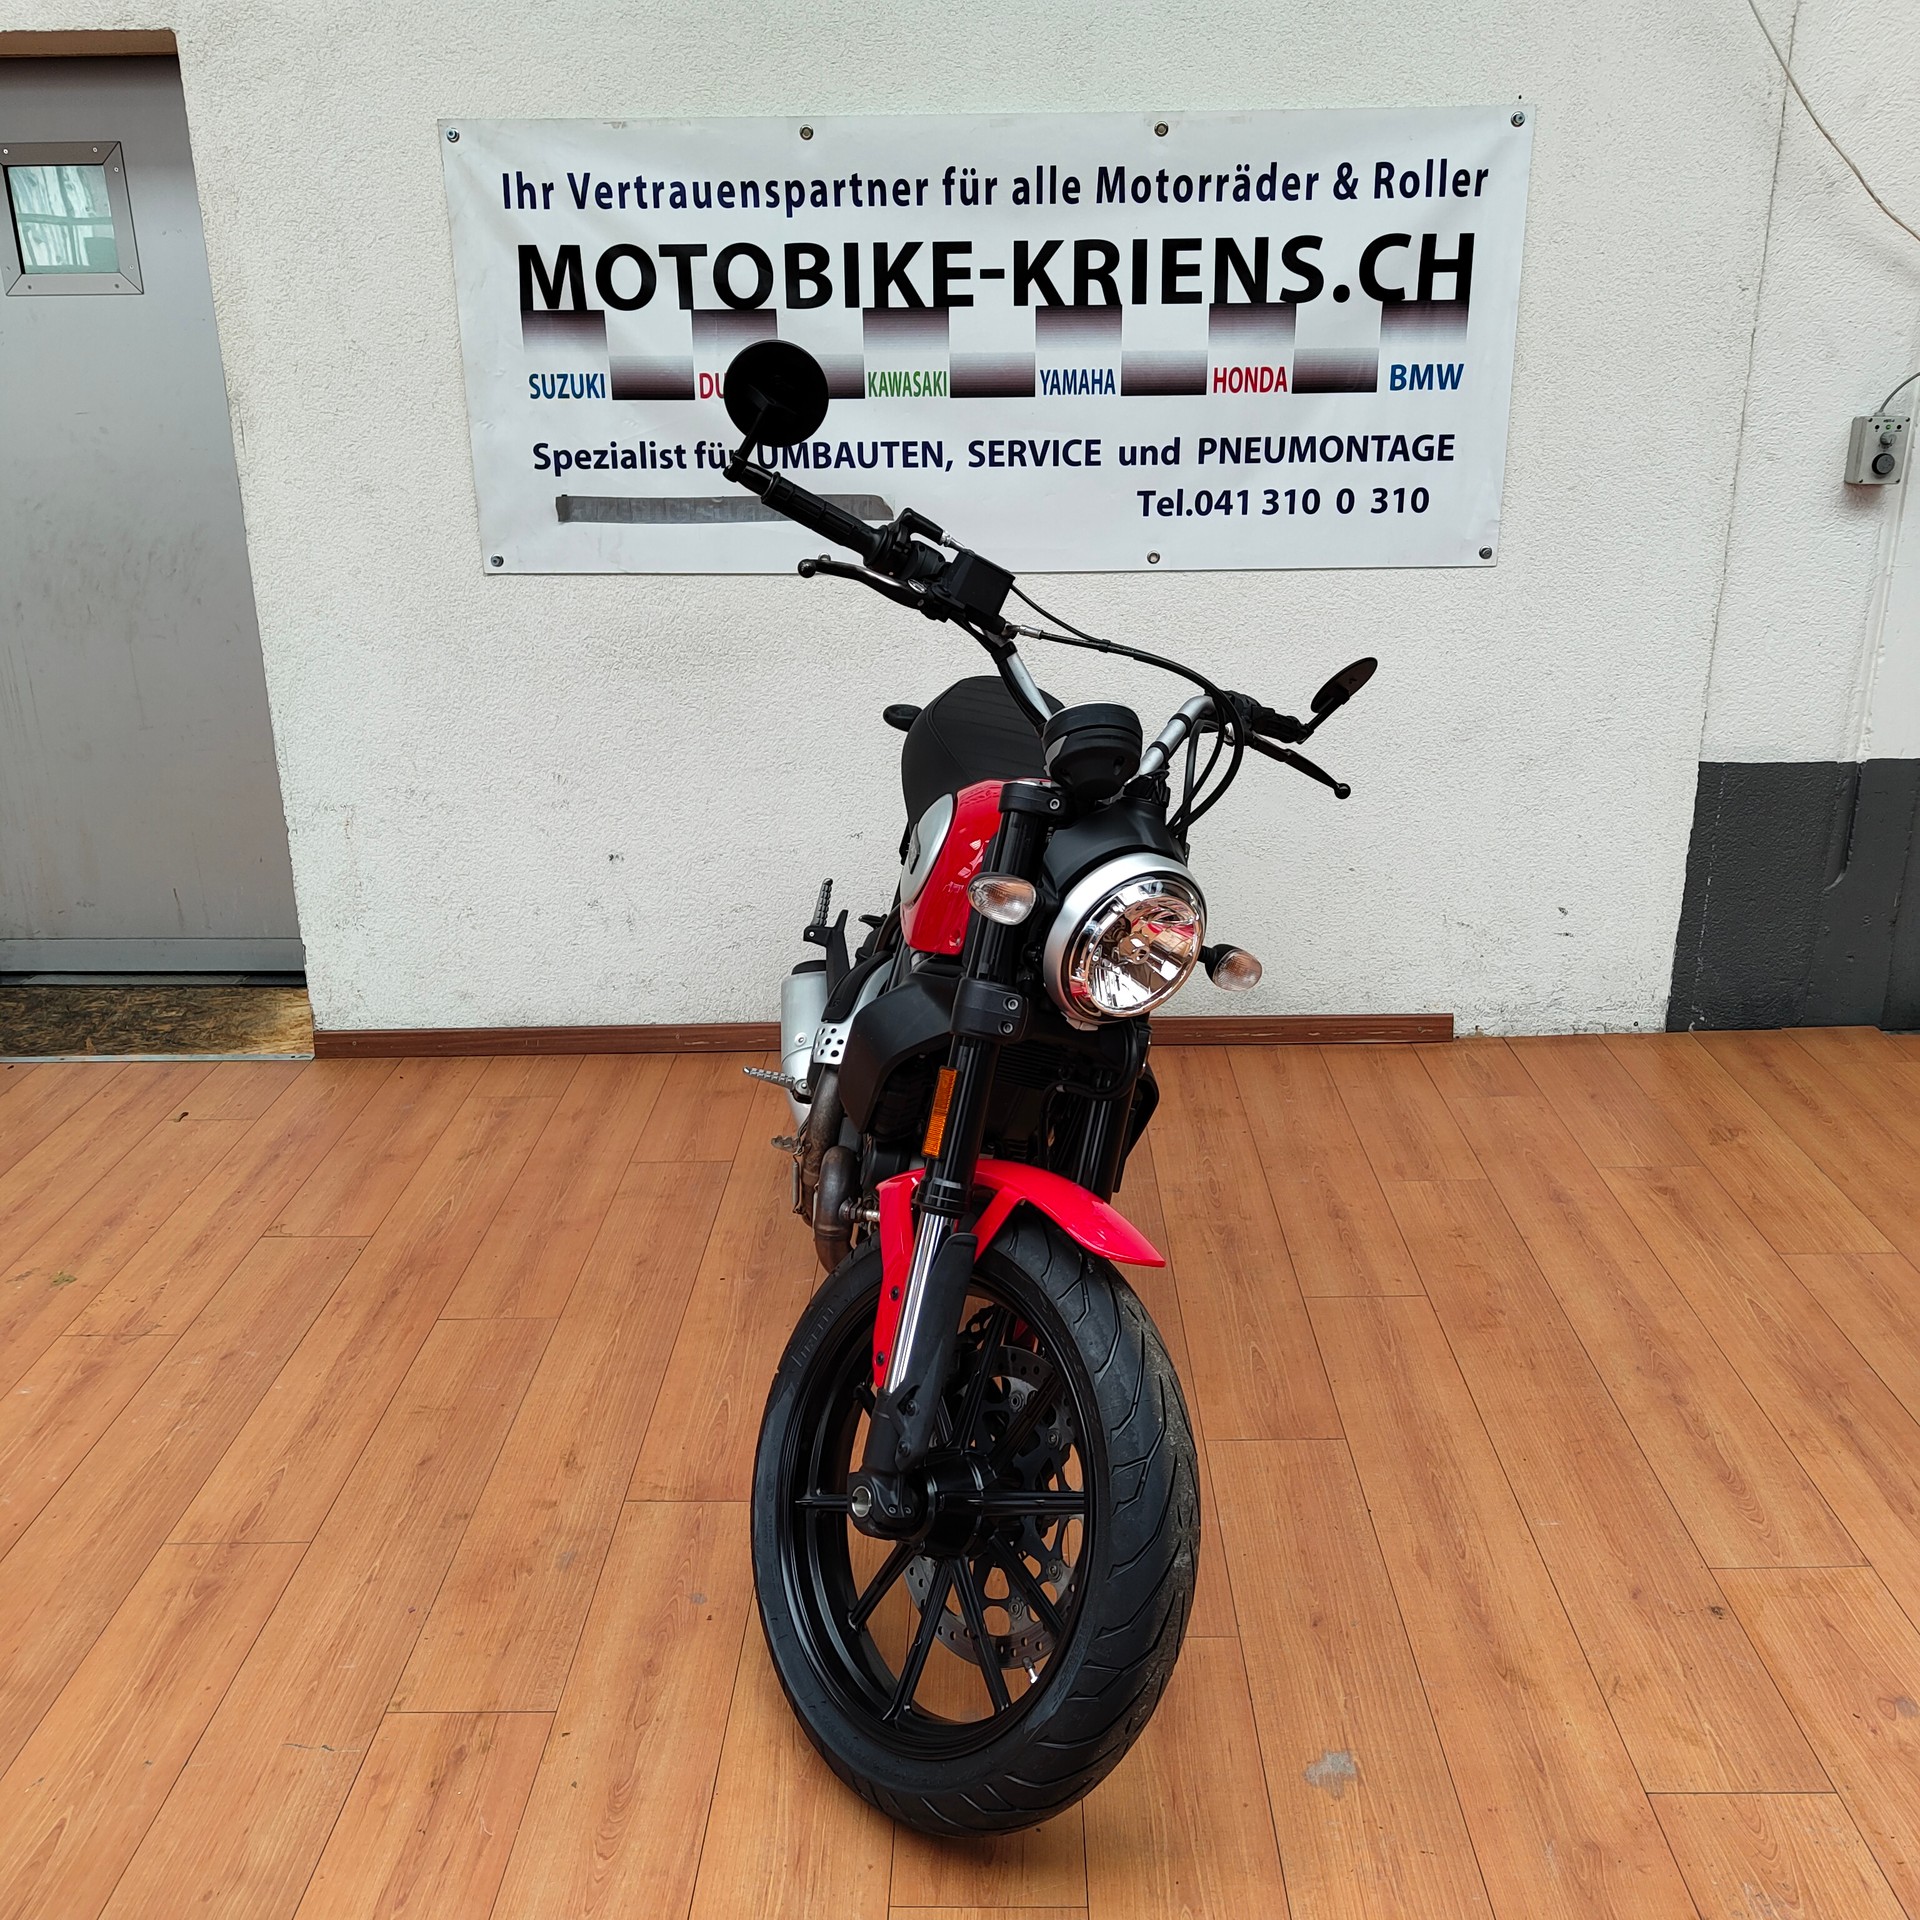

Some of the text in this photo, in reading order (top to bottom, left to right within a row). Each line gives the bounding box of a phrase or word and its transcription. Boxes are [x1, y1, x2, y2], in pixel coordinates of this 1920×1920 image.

[503, 159, 1488, 218] Ihr Vertrauenspartner für alle Motorräder & Roller
[518, 233, 1475, 311] MOTOBIKE-KRIENS.CH
[529, 364, 1464, 399] SUZUKI KAWASAKI YAMAHA HONDA BMW
[533, 441, 687, 477] Spezialist
[757, 441, 953, 472] UMBAUTEN,
[969, 439, 1101, 467] SERVICE
[1119, 437, 1180, 466] und
[1198, 434, 1455, 464] PNEUMONTAGE
[1137, 487, 1429, 516] Tel.041 310 0 310
